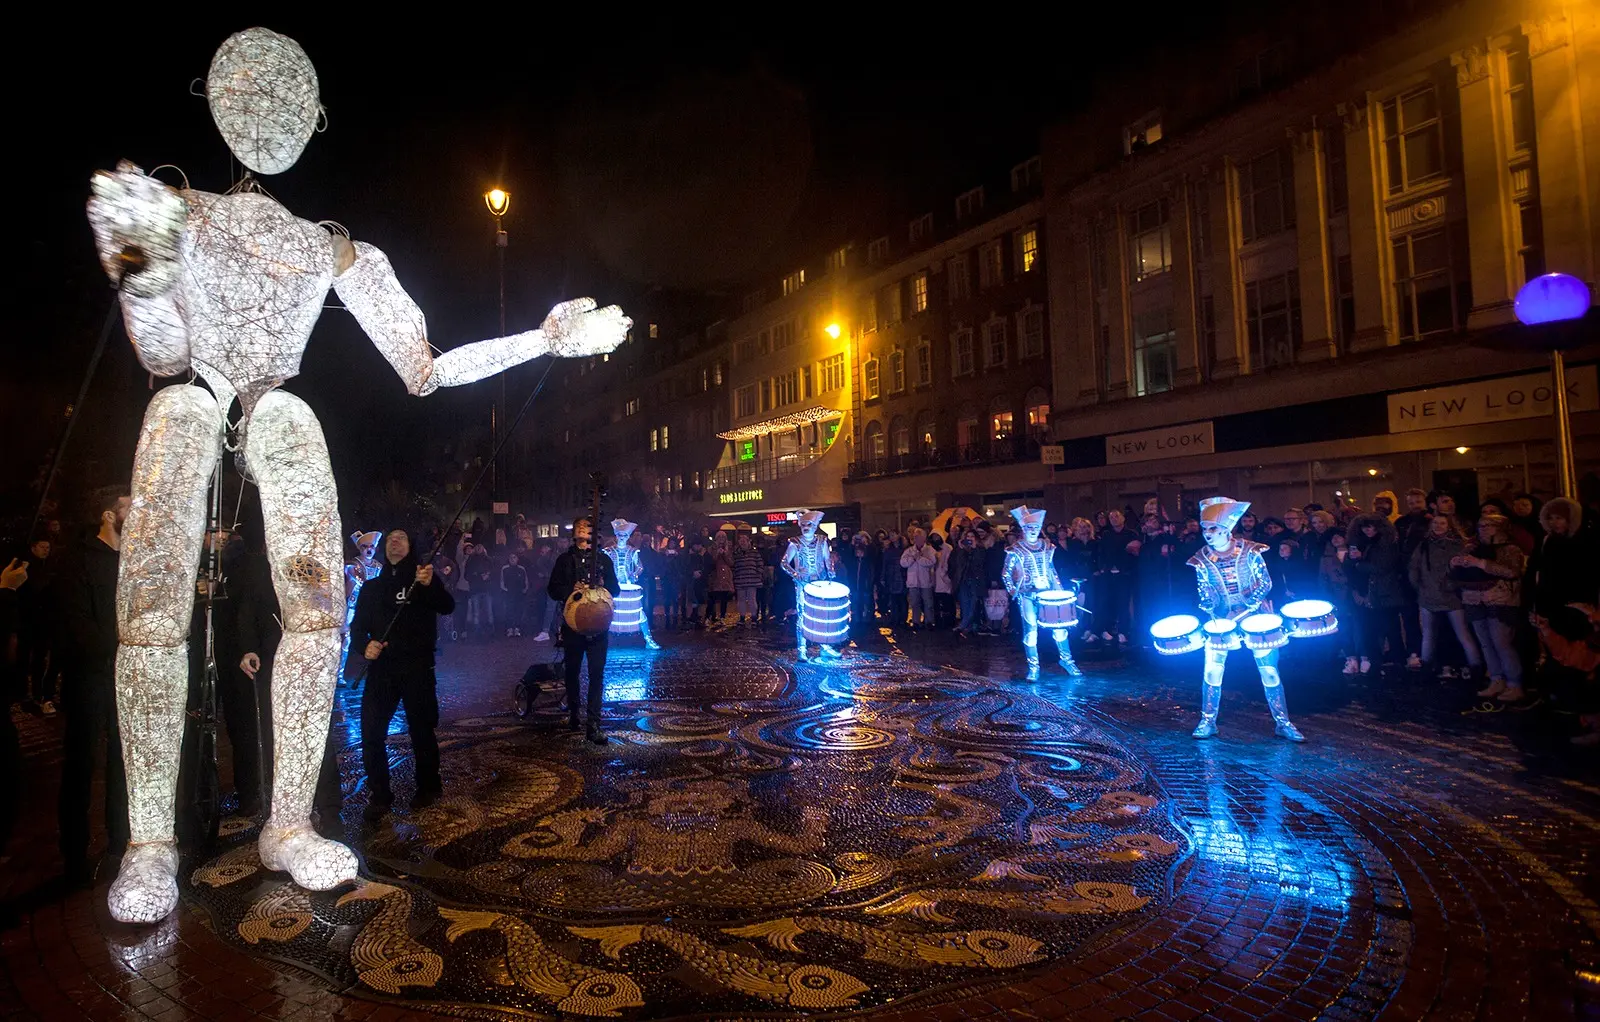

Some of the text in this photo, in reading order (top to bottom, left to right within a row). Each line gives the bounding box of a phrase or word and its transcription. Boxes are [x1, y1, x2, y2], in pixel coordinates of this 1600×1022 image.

[1399, 381, 1580, 420] NEW LOOK
[1111, 432, 1205, 455] NEW LOOK
[767, 513, 786, 522] TESCO
